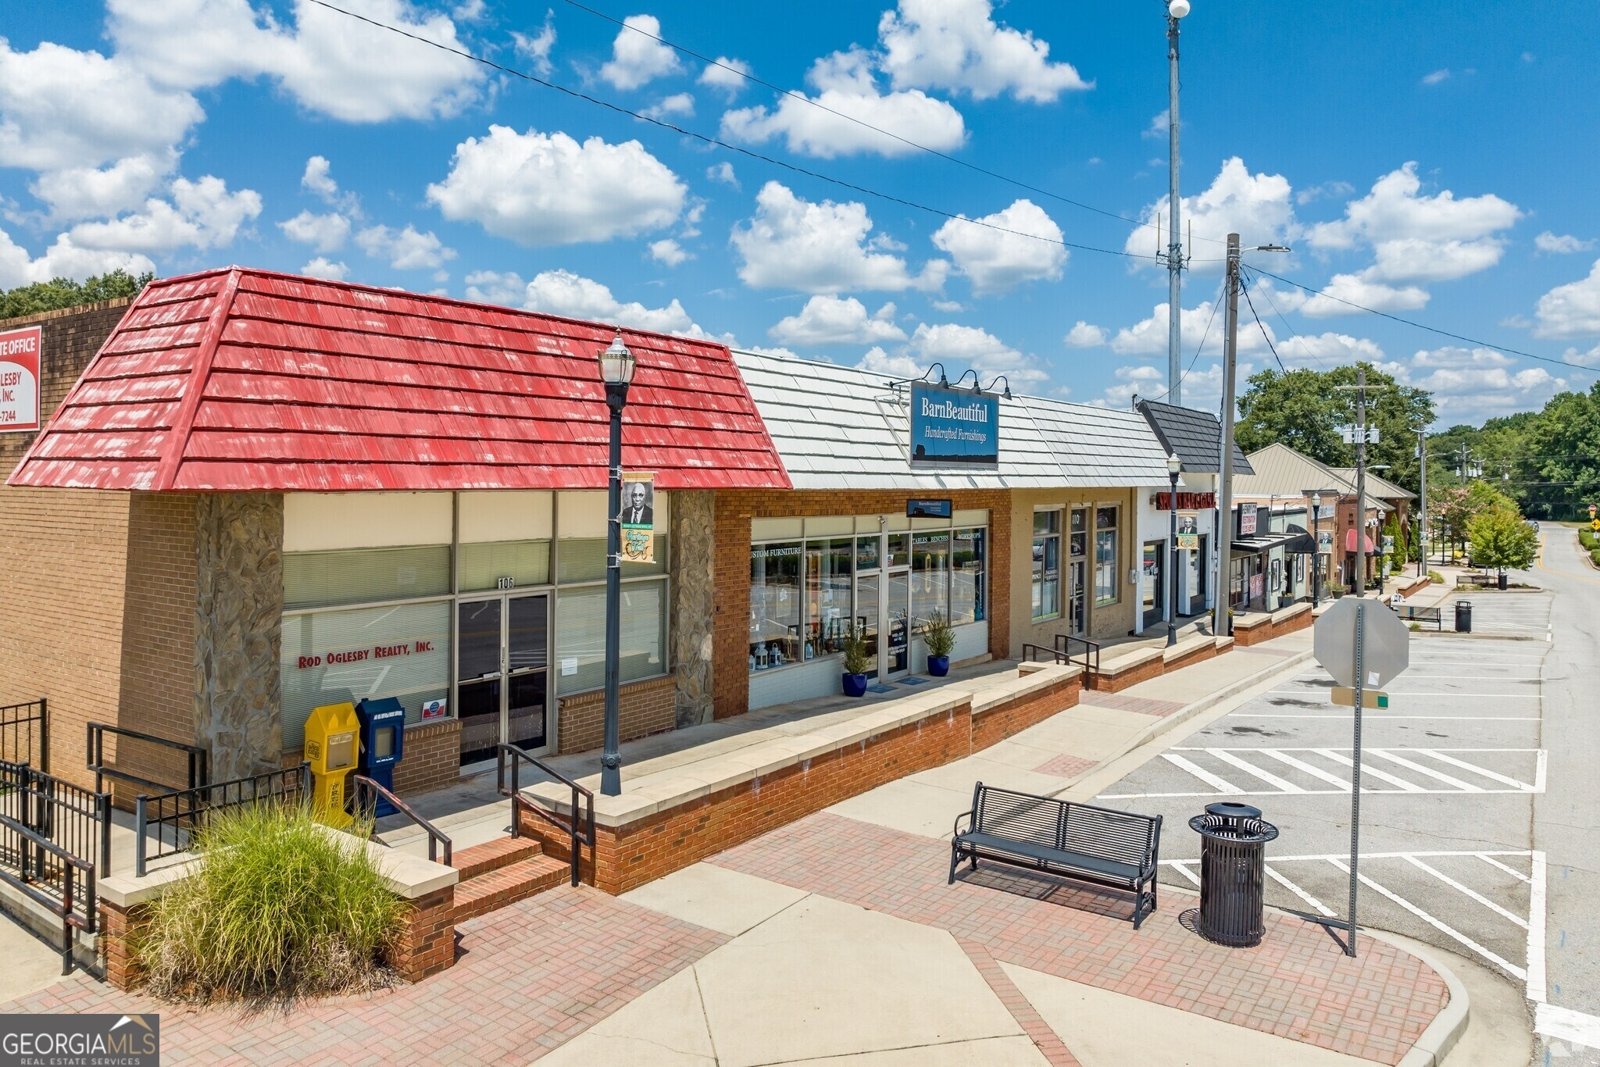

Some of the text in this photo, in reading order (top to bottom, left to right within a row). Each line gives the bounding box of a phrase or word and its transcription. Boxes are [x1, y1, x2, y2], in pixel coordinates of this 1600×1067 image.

[9, 336, 36, 355] OFFICE
[2, 388, 16, 401] INC.
[921, 397, 988, 423] BarnBeautiful
[924, 425, 987, 444] Handcrafted Furnishings
[770, 547, 802, 557] FURNITURE
[498, 576, 514, 589] 106
[298, 641, 435, 669] ROD OGLESBY REALTY, INC.
